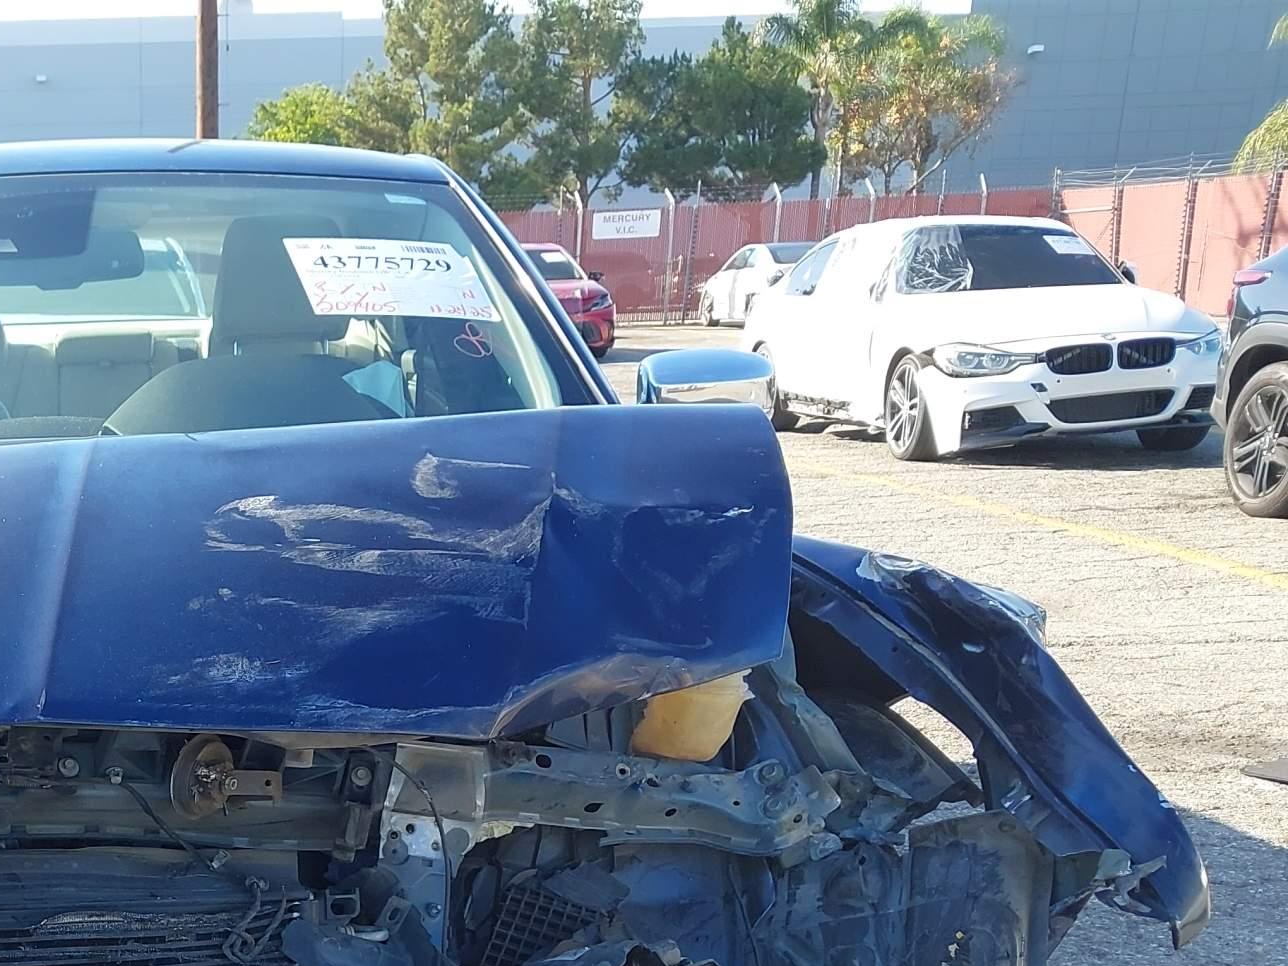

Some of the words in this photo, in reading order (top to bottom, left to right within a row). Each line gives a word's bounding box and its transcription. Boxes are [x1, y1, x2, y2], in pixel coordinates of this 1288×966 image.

[603, 214, 651, 223] MERCURY
[615, 226, 637, 234] V.I.C.
[313, 255, 452, 272] 43775729
